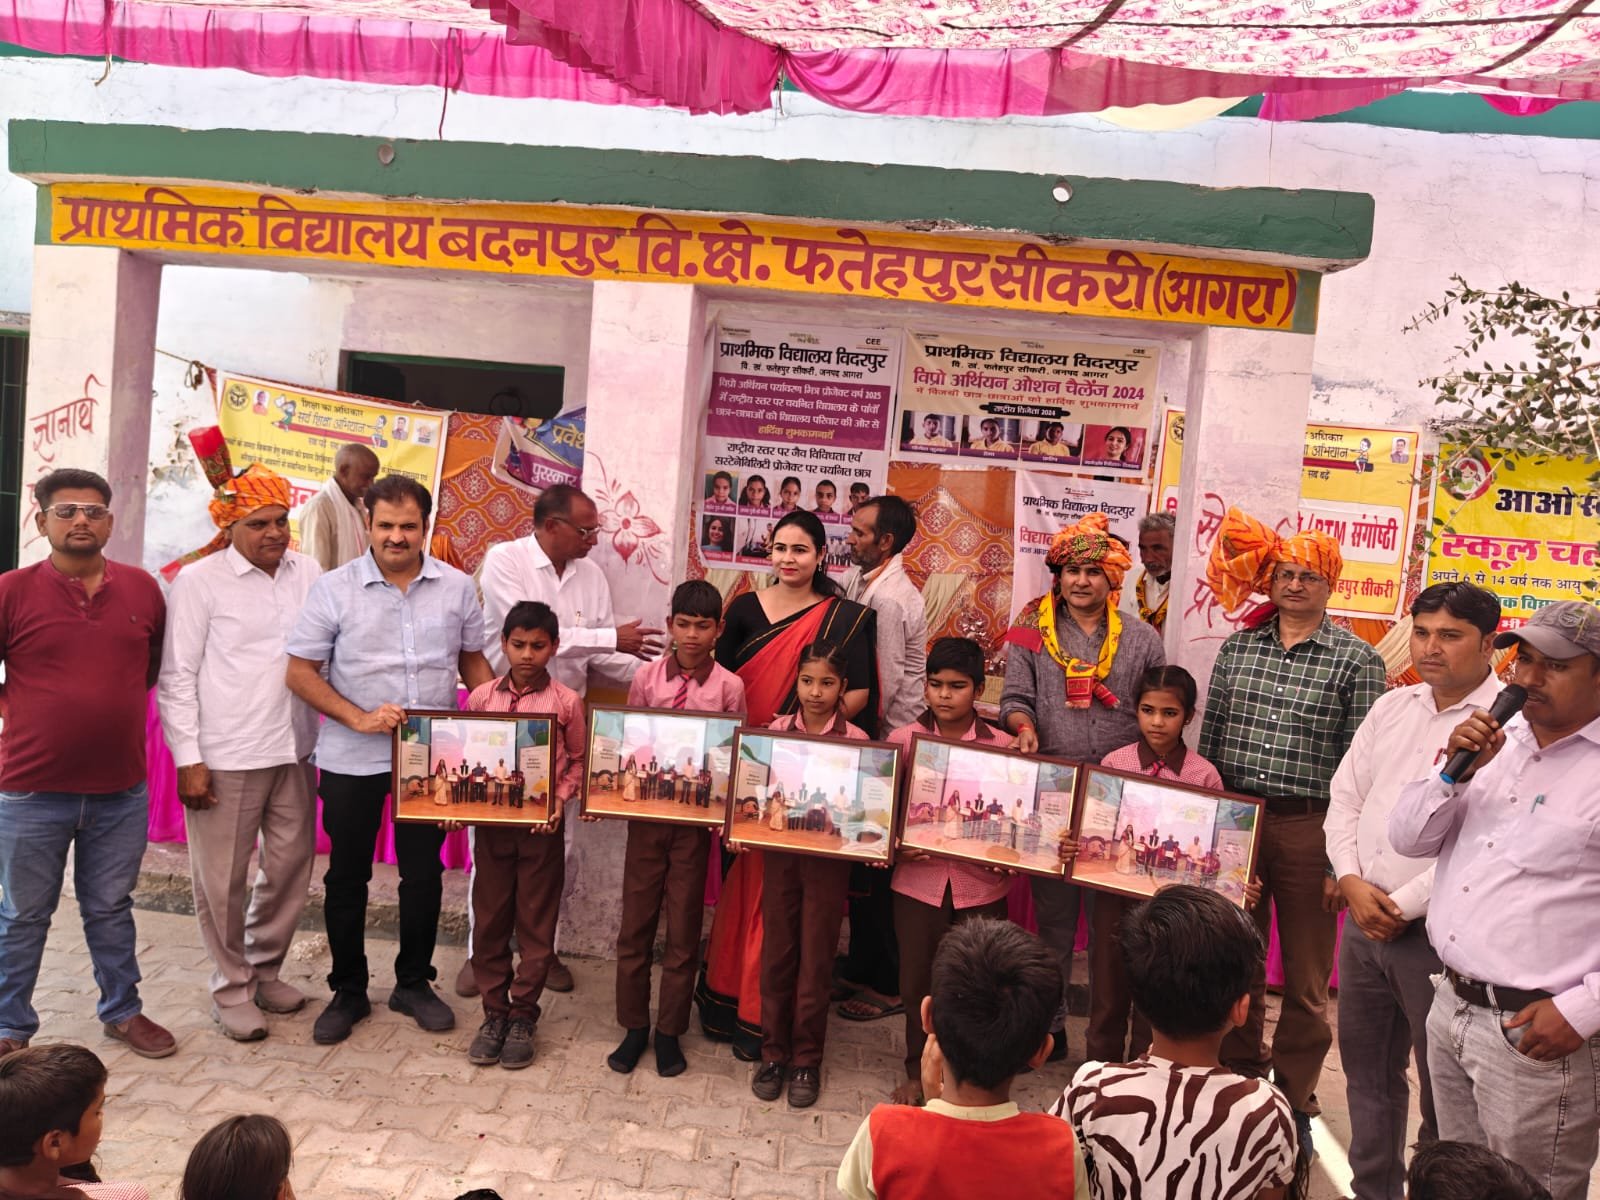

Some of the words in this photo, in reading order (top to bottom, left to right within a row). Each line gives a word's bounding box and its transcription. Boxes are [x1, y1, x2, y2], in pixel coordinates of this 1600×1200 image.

[59, 187, 244, 247] प्राथमिक
[254, 194, 435, 261] विद्यालय
[440, 218, 628, 277] बदनपुर
[772, 229, 989, 302] फतेहपुर
[989, 244, 1155, 310] सीकरी
[1153, 261, 1297, 325] (आगरा)
[865, 338, 881, 346] CEE
[720, 340, 775, 359] प्राथमिक
[780, 343, 832, 366] विद्यालय
[836, 347, 887, 372] विदरपुर
[925, 344, 995, 361] प्राथमिक
[1000, 348, 1067, 366] विद्यालय
[1074, 353, 1139, 374] विदरपुर
[766, 363, 790, 376] फतेहपुर
[820, 369, 839, 379] जनपद
[842, 370, 862, 379] आगरा
[984, 362, 1014, 374] फतेहपुर
[1053, 368, 1078, 377] जनपद
[1082, 370, 1108, 379] आगरा
[770, 381, 802, 394] पर्यावरण
[804, 384, 820, 395] मित्र
[865, 391, 881, 400] 2025
[914, 366, 946, 385] विप्रो
[950, 370, 1007, 390] अर्थियन
[1012, 375, 1060, 394] ओशन
[1112, 385, 1145, 400] 2024
[729, 394, 752, 405] राष्ट्रीय
[755, 397, 771, 406] स्तर
[773, 398, 783, 407] पर
[786, 398, 813, 409] चयनित
[816, 400, 847, 412] विद्यालय
[850, 403, 858, 412] के
[766, 410, 777, 420] को
[780, 411, 810, 424] विद्यालय
[813, 414, 839, 425] परिवार
[841, 415, 853, 426] की
[855, 416, 870, 427] ओर
[872, 419, 880, 428] से
[1310, 430, 1343, 442] अधिकार
[727, 441, 754, 454] राष्ट्रीय
[757, 446, 775, 455] स्तर
[777, 447, 789, 456] पर
[791, 446, 806, 458] जैव
[810, 448, 845, 461] विविधता
[848, 451, 863, 462] एवं
[1312, 444, 1348, 458] अभियान
[531, 463, 577, 486] पुरस्कार
[773, 459, 803, 472] प्रोजेक्ट
[806, 464, 818, 473] पर
[820, 464, 851, 477] चयनित
[854, 467, 871, 478] छात्र
[1023, 496, 1060, 509] प्राथमिक
[1062, 498, 1098, 512] विद्यालय
[1101, 502, 1136, 519] विदरपुर
[1495, 487, 1576, 516] आओ
[1442, 533, 1541, 571] स्कूल
[1333, 580, 1358, 600] हपुर
[1361, 577, 1393, 598] सीकरी
[1432, 569, 1458, 581] अपने
[1475, 572, 1485, 584] से
[1492, 575, 1505, 584] 14
[1511, 574, 1528, 587] वर्ष
[1532, 578, 1552, 588] तक
[1557, 580, 1581, 594] आयु
